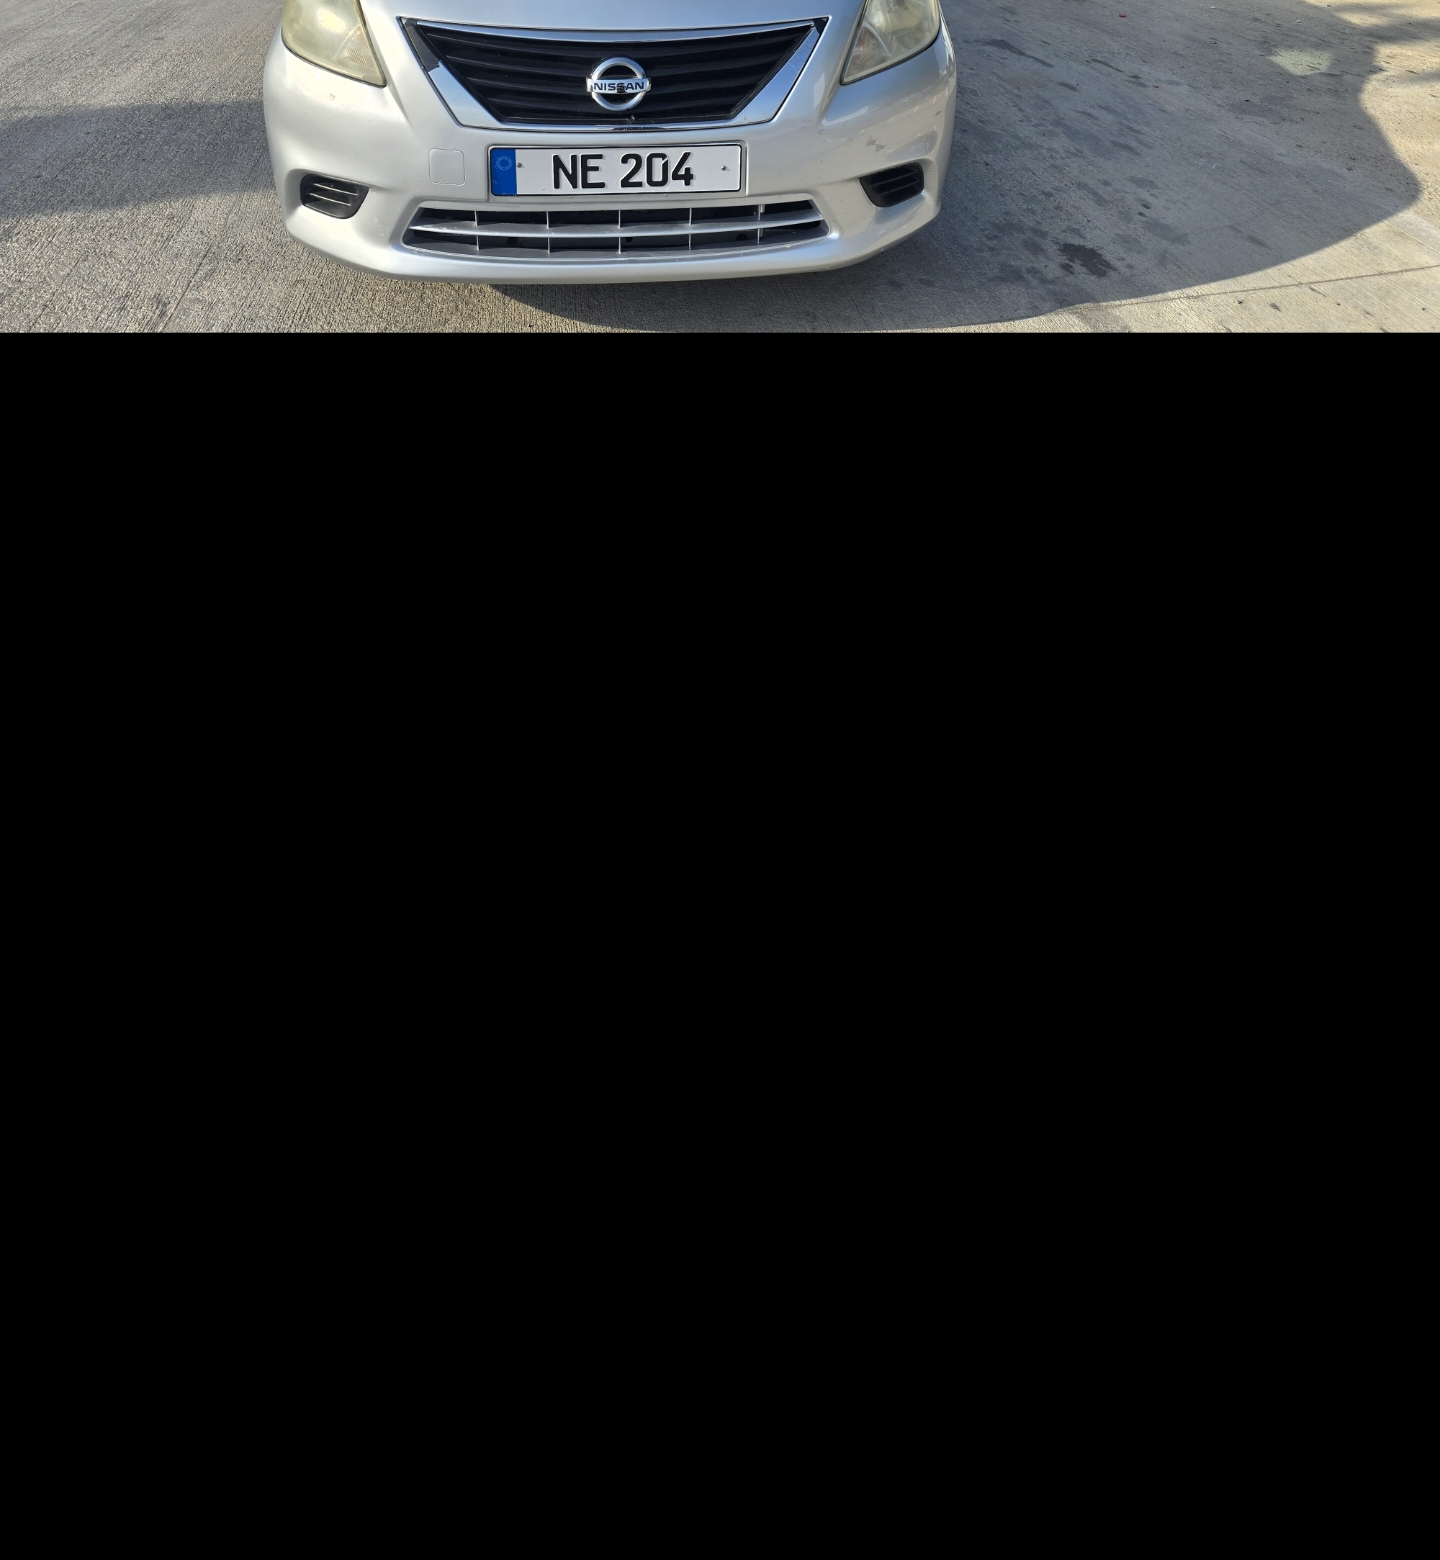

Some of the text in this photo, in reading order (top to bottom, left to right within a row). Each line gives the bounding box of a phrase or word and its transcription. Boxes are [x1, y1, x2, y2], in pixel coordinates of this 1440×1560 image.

[593, 81, 644, 91] NISSAN
[552, 151, 693, 190] NE 204
